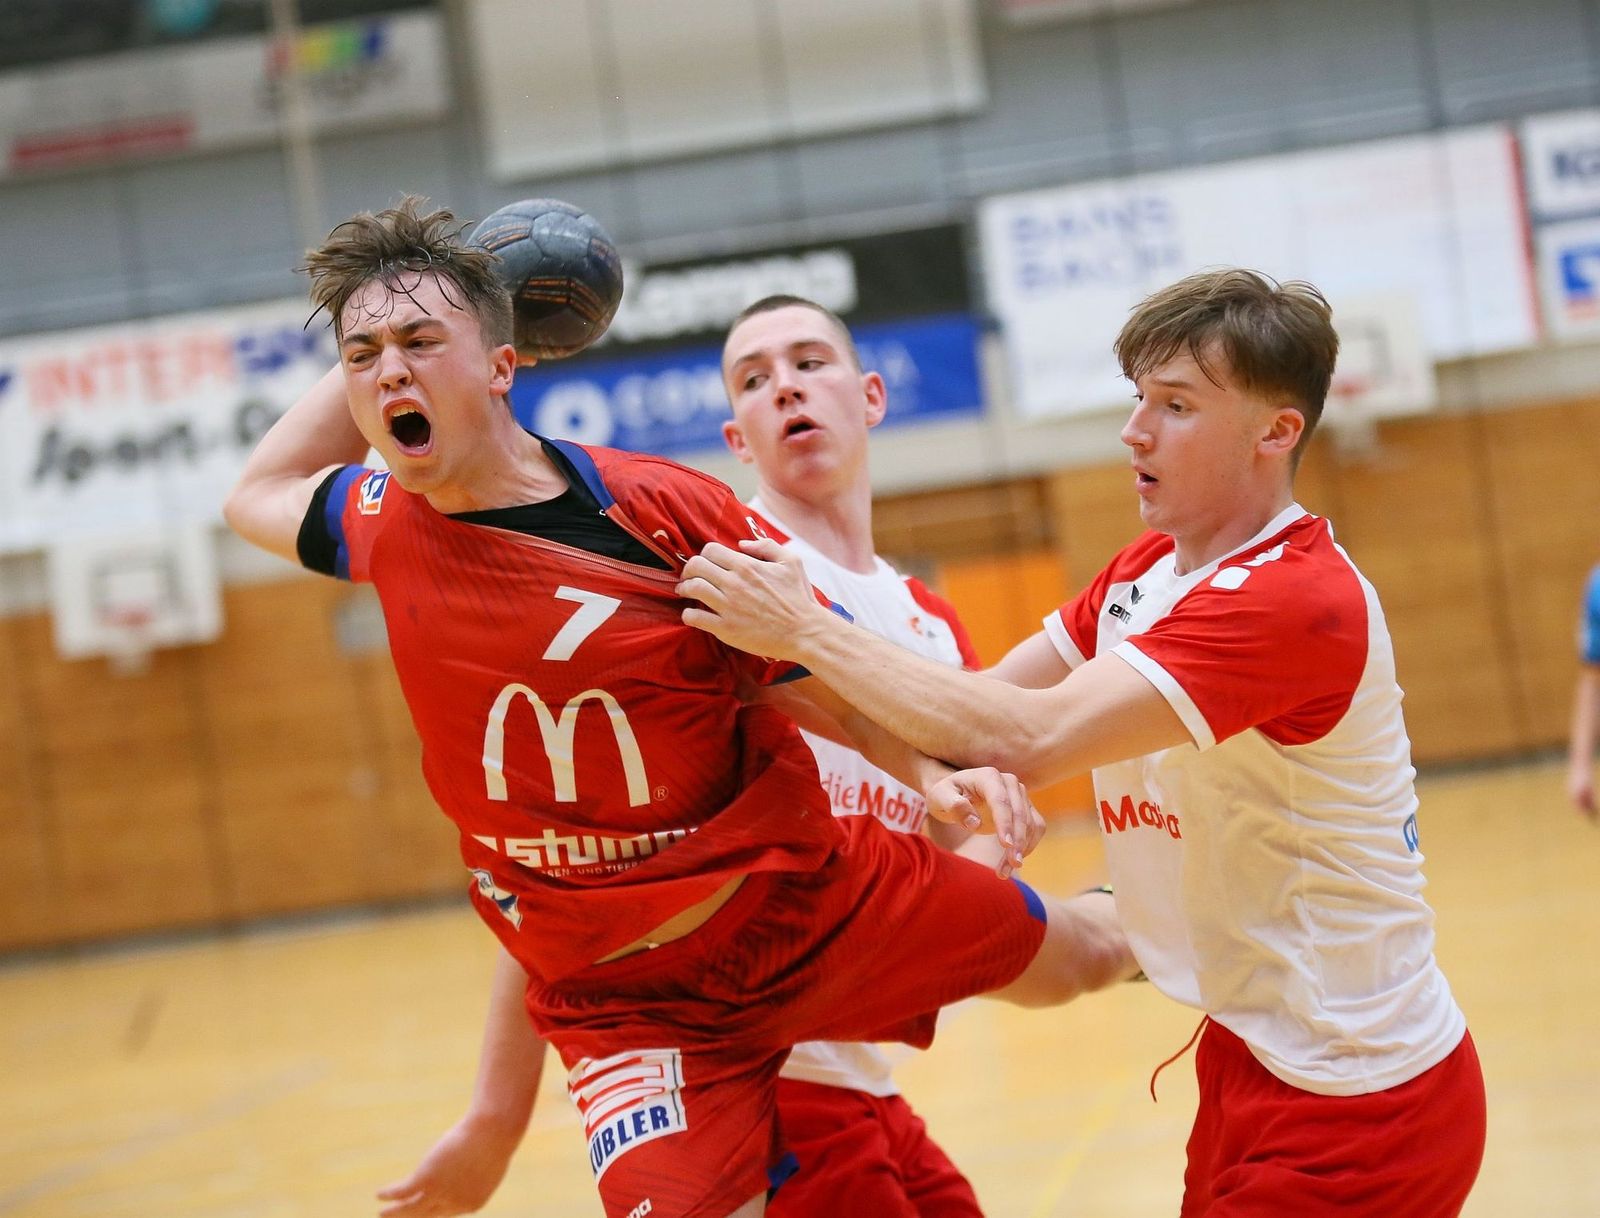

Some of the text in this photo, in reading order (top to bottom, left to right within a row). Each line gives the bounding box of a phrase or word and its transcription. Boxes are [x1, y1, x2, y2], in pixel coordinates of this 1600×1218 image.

[542, 585, 622, 661] 7
[577, 867, 602, 875] UND
[590, 1105, 670, 1174] ÜBLER
